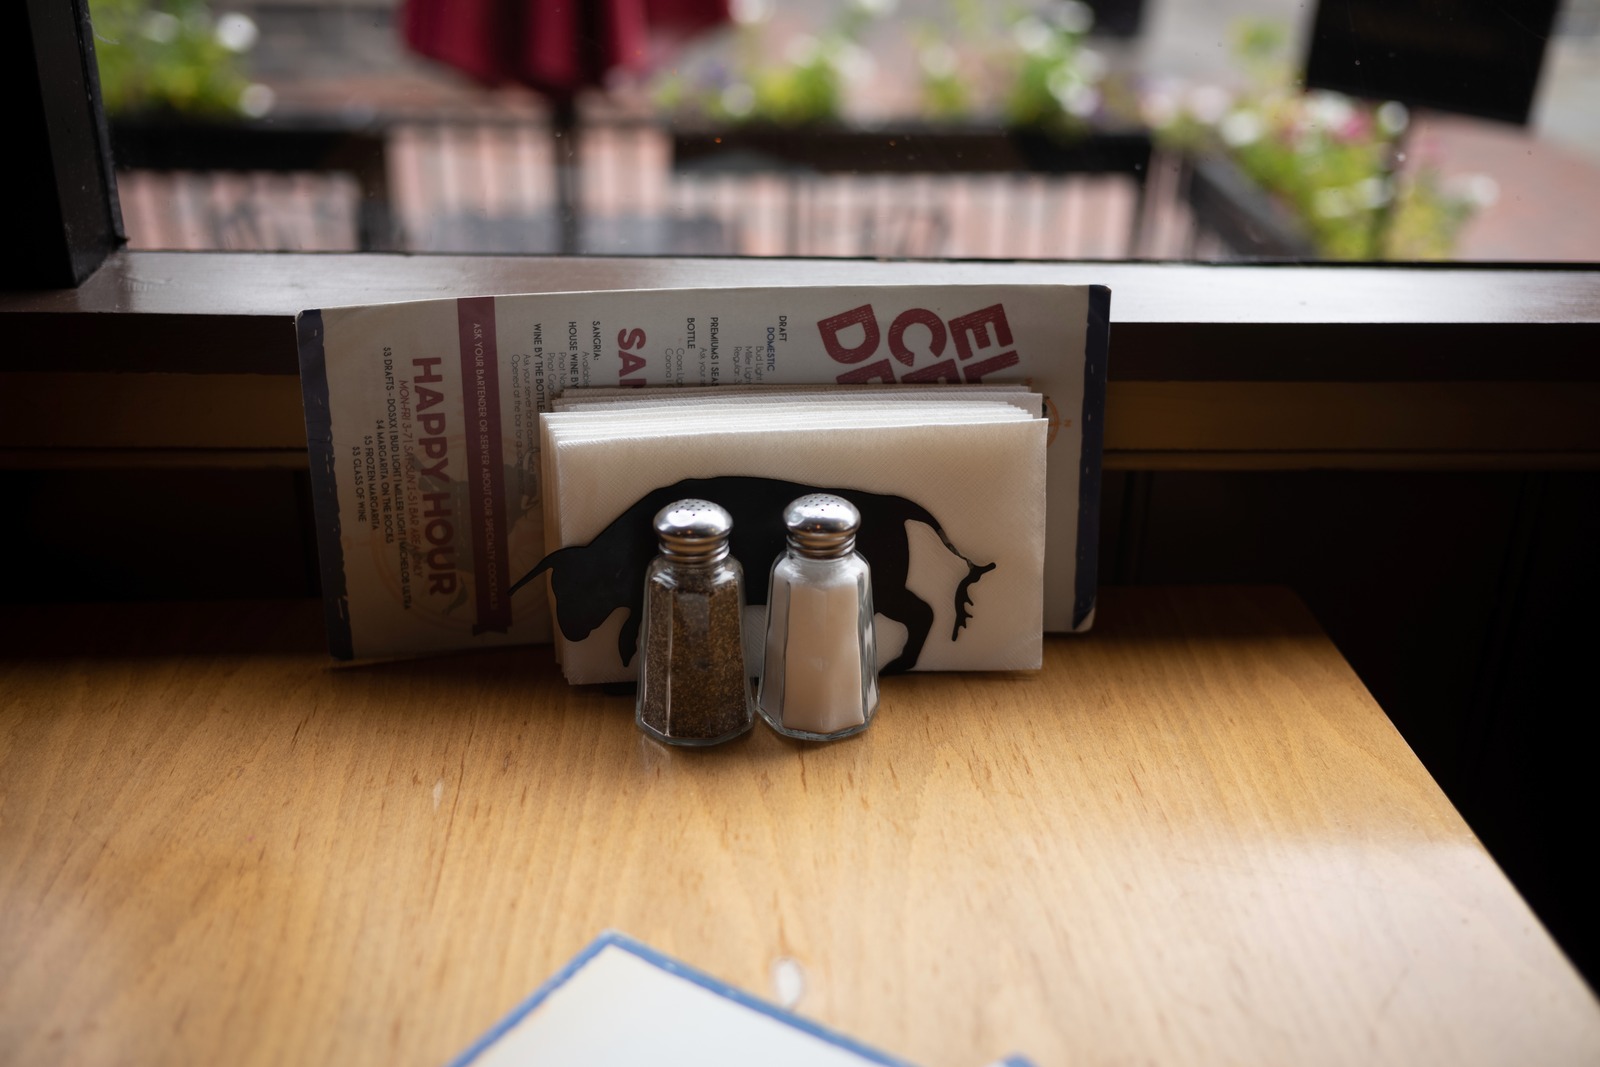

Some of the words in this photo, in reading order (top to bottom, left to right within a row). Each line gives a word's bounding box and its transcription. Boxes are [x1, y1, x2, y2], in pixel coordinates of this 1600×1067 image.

[474, 324, 482, 340] ASK
[533, 323, 542, 345] WINE
[568, 321, 578, 351] HOUSE
[592, 320, 602, 360] SANGRIA:
[686, 318, 696, 349] BOTTLE
[710, 317, 720, 360] PREMIUMS
[778, 316, 788, 342] DRAFT
[382, 346, 392, 357] $3
[474, 342, 484, 367] YOUR
[522, 354, 532, 366] Ask
[534, 347, 543, 359] BY
[698, 348, 708, 360] Ask
[744, 346, 754, 364] Miller
[755, 346, 764, 362] Bud
[766, 327, 775, 372] DOMESTIC
[511, 354, 521, 388] Opened
[535, 360, 544, 376] THE
[547, 352, 556, 372] Pinot
[558, 352, 567, 371] Pinot
[570, 353, 578, 375] WINE
[664, 348, 674, 378] Corona
[697, 361, 706, 378] your
[754, 363, 764, 380] Light
[384, 359, 394, 390] DRAFTS
[522, 368, 530, 384] your
[570, 377, 579, 389] BY
[475, 370, 488, 417] BARTENDER
[514, 390, 522, 399] at
[386, 398, 398, 428] DOSXX
[514, 400, 522, 412] the
[376, 420, 385, 430] $4
[412, 357, 450, 482] HAPPY
[480, 420, 488, 432] OR
[352, 446, 360, 456] $3
[364, 435, 373, 446] $5
[390, 435, 400, 452] BUD
[480, 434, 490, 465] SERVER
[365, 448, 376, 481] FROZEN
[377, 432, 389, 480] MARGARITA
[392, 454, 402, 478] LIGHT
[353, 458, 364, 486] GLASS
[482, 468, 492, 496] ABOUT
[355, 487, 366, 500] OF
[381, 482, 390, 496] ON
[394, 484, 404, 510] MILLER
[358, 501, 368, 522] WINE
[368, 484, 380, 530] MARGARITA
[382, 498, 392, 513] THE
[484, 498, 493, 516] OUR
[384, 514, 394, 544] ROCKS
[396, 513, 406, 536] LIGHT
[422, 492, 457, 596] HOUR
[486, 518, 496, 560] SPECIALTY
